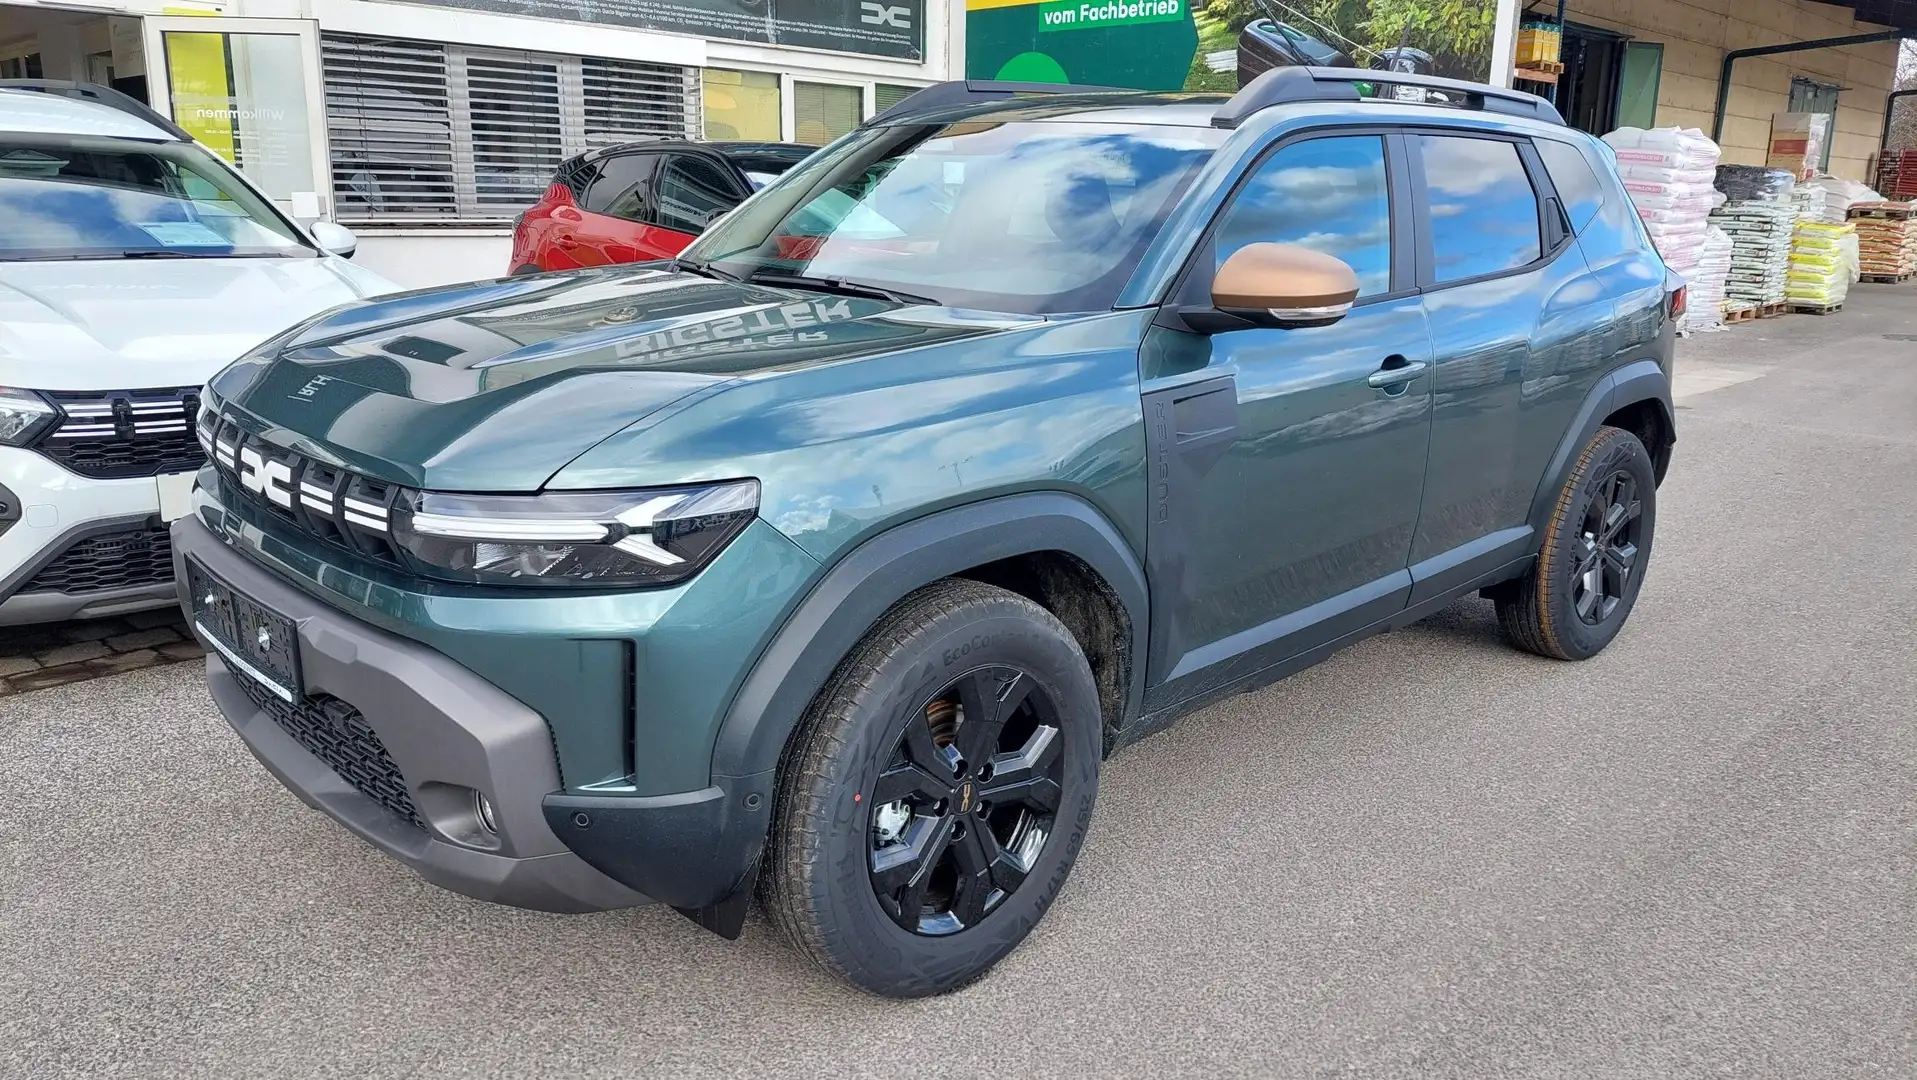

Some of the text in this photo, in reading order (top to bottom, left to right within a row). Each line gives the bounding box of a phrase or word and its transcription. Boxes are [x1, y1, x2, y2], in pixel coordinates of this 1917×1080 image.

[1044, 0, 1179, 25] vom Fachbetrieb
[1156, 402, 1170, 525] DUSTER
